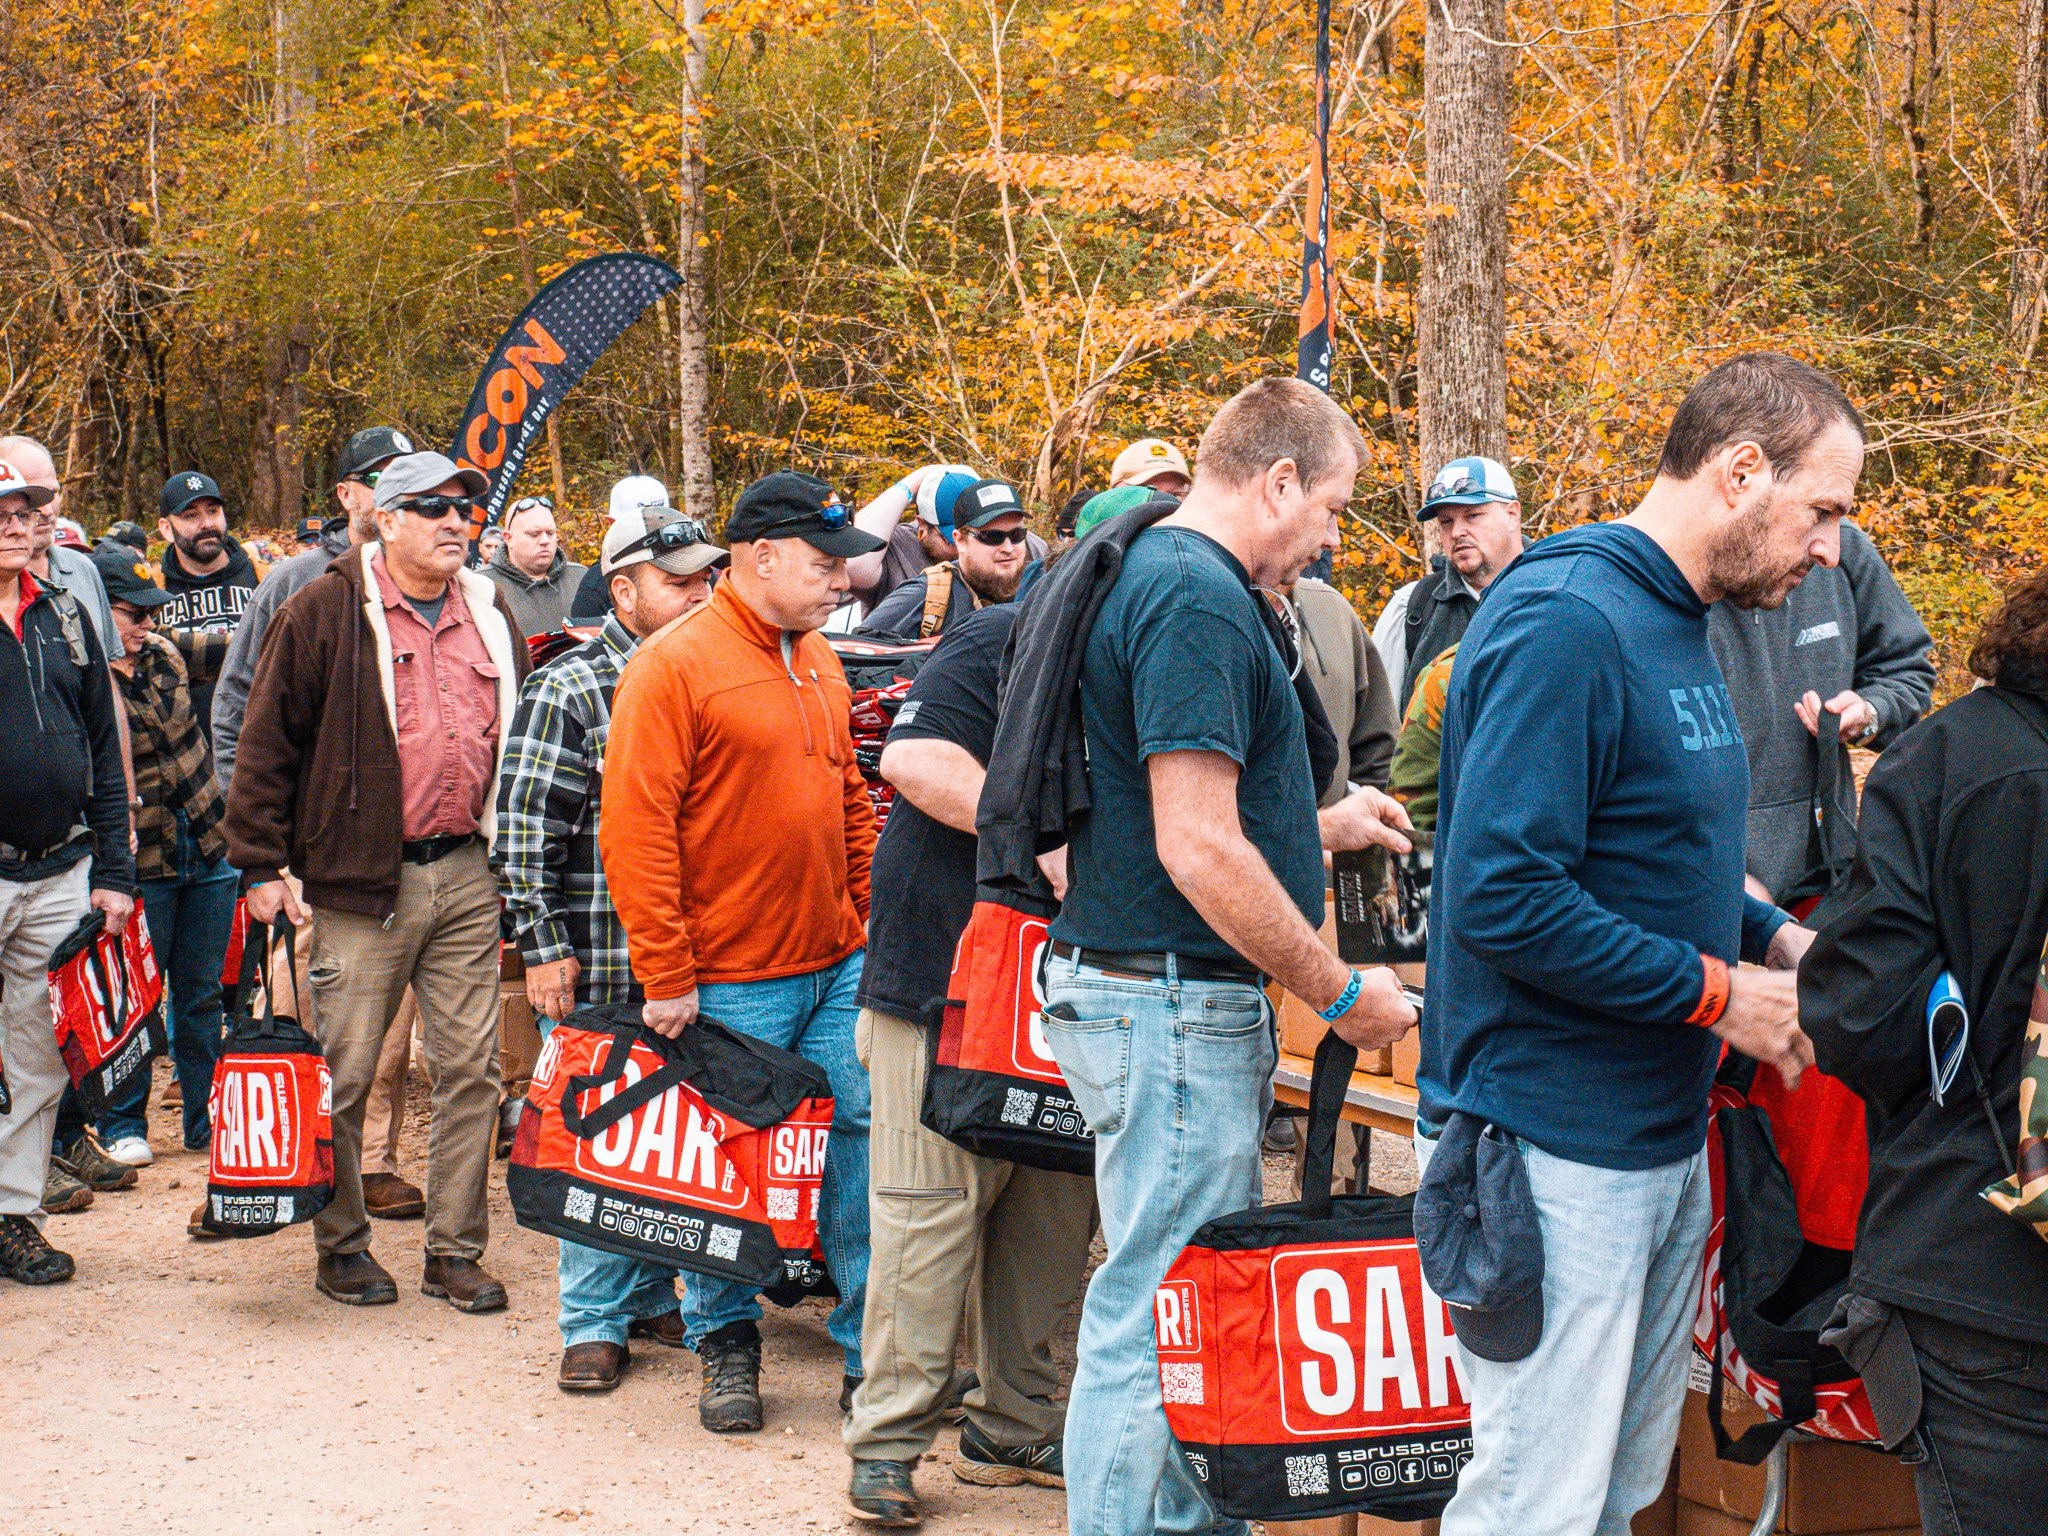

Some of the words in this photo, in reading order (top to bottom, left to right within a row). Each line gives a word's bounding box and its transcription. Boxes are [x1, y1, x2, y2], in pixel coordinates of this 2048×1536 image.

[531, 396, 550, 422] DAY
[159, 585, 254, 627] CAROLIN
[1344, 871, 1358, 922] SMOKE
[220, 1071, 279, 1168] SAR
[602, 1197, 705, 1230] sarusa.com
